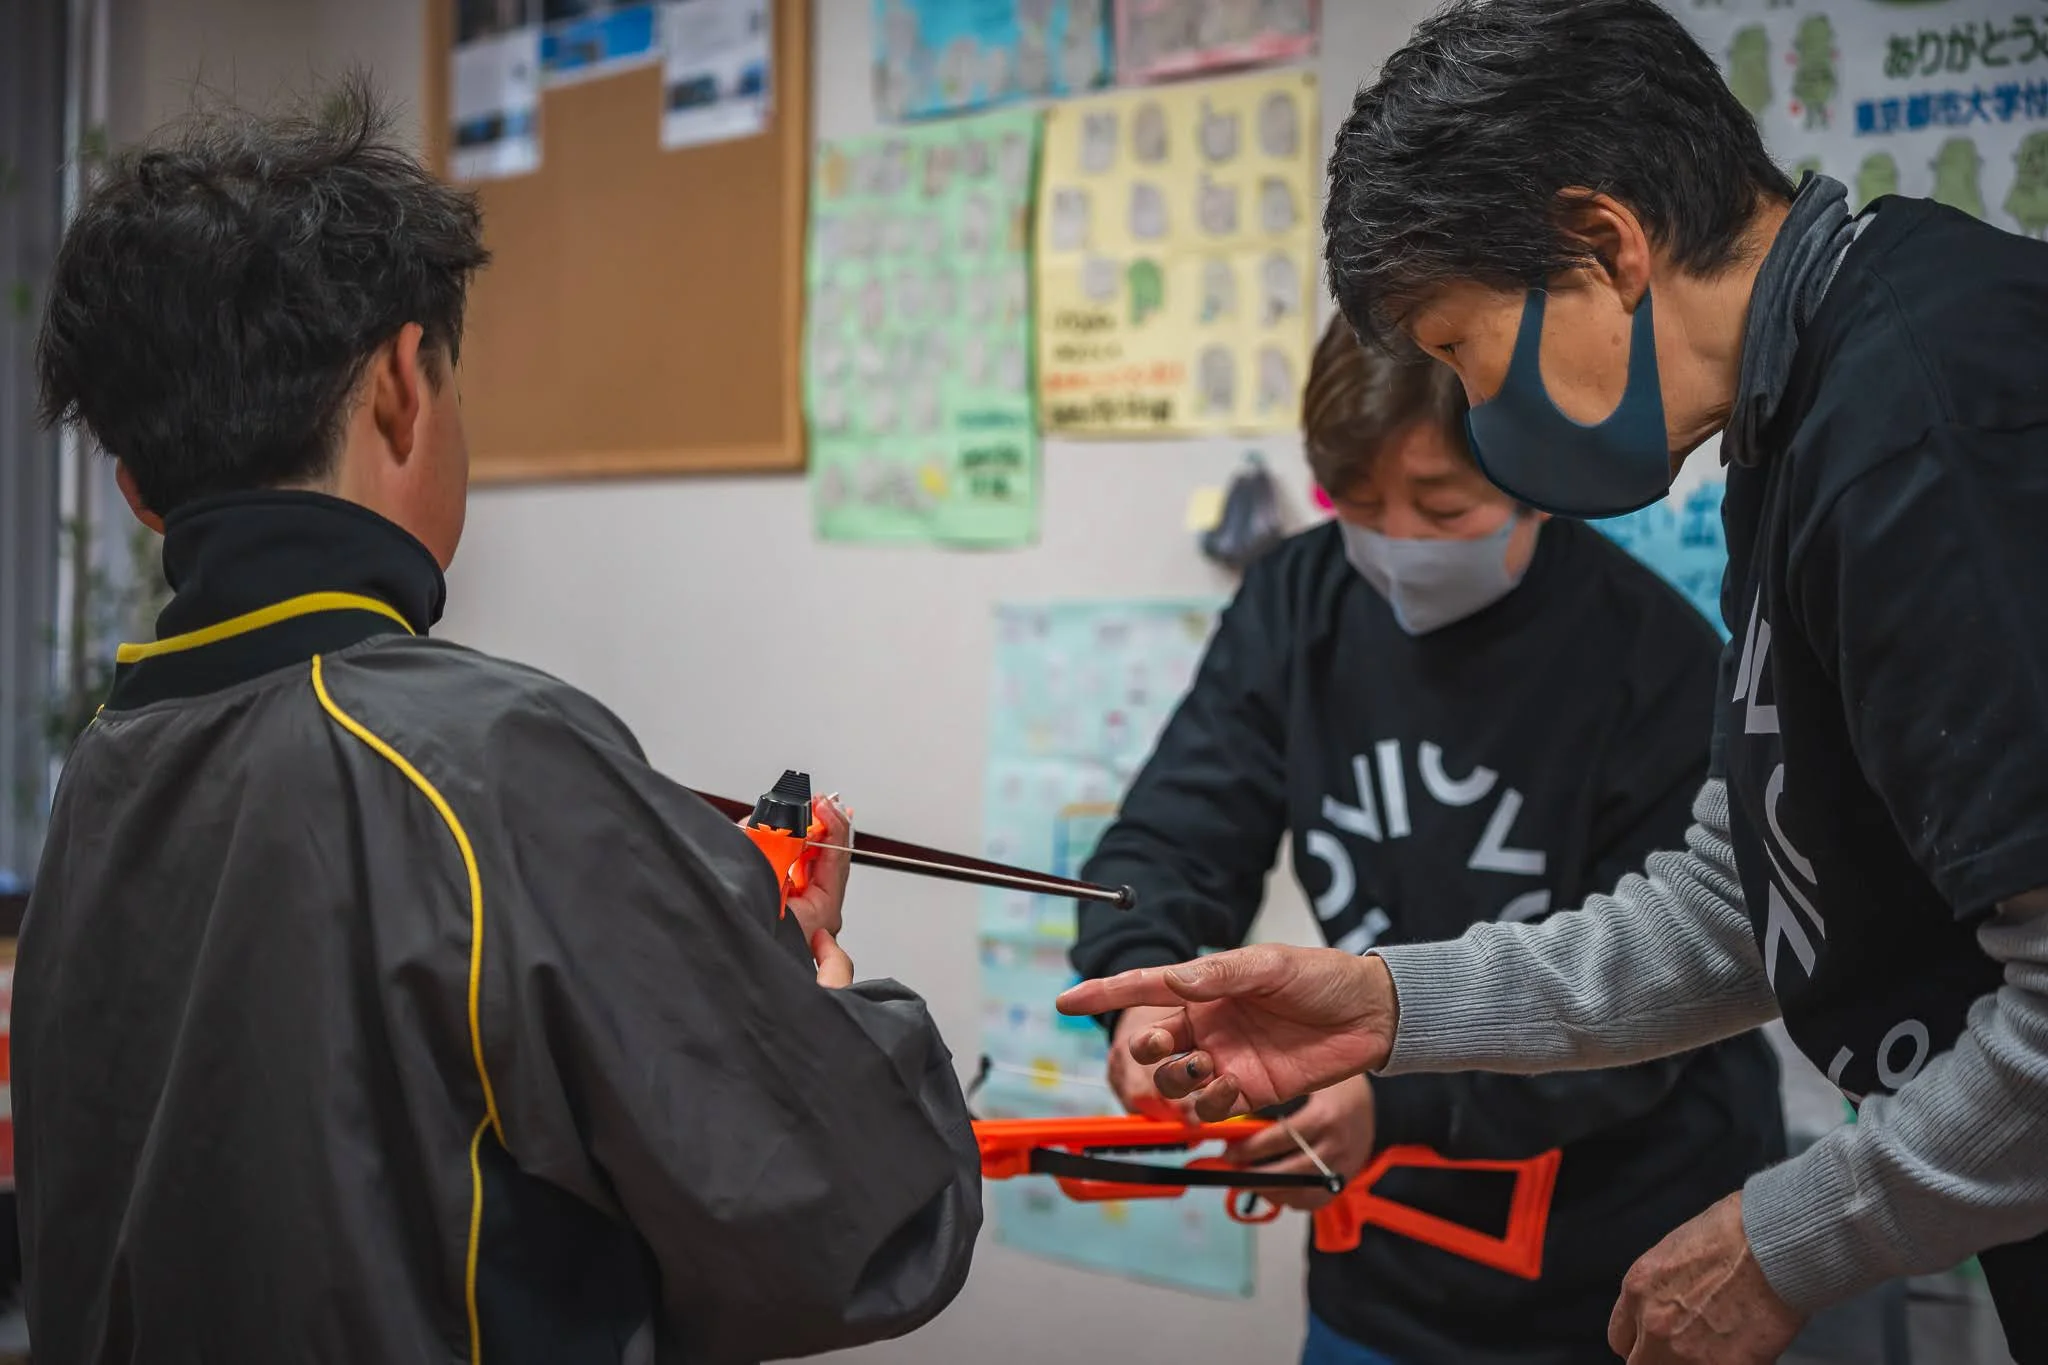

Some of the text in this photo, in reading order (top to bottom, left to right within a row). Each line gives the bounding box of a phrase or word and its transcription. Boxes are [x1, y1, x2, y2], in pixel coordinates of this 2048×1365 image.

[1883, 14, 2048, 79] ありがとう
